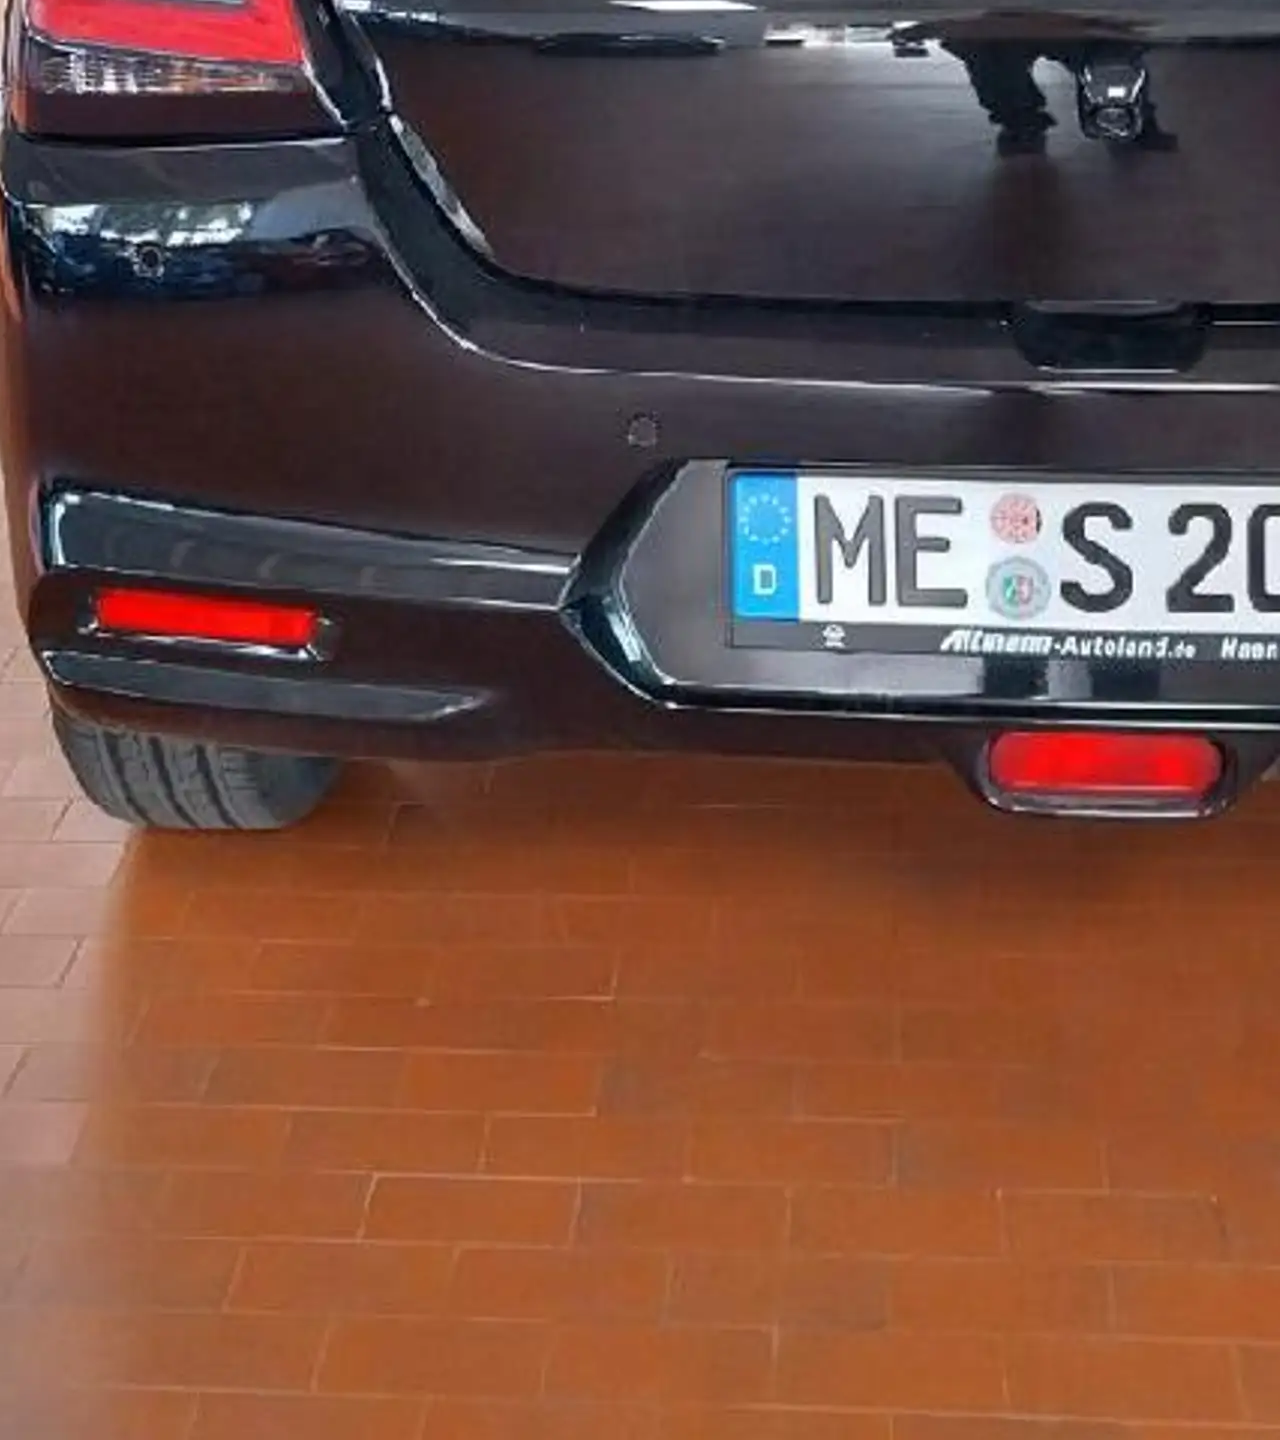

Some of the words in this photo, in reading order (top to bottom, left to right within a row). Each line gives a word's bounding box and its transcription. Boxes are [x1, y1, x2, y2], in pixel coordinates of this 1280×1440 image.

[753, 563, 777, 595] D
[814, 494, 969, 608] ME
[1060, 501, 1134, 613] S
